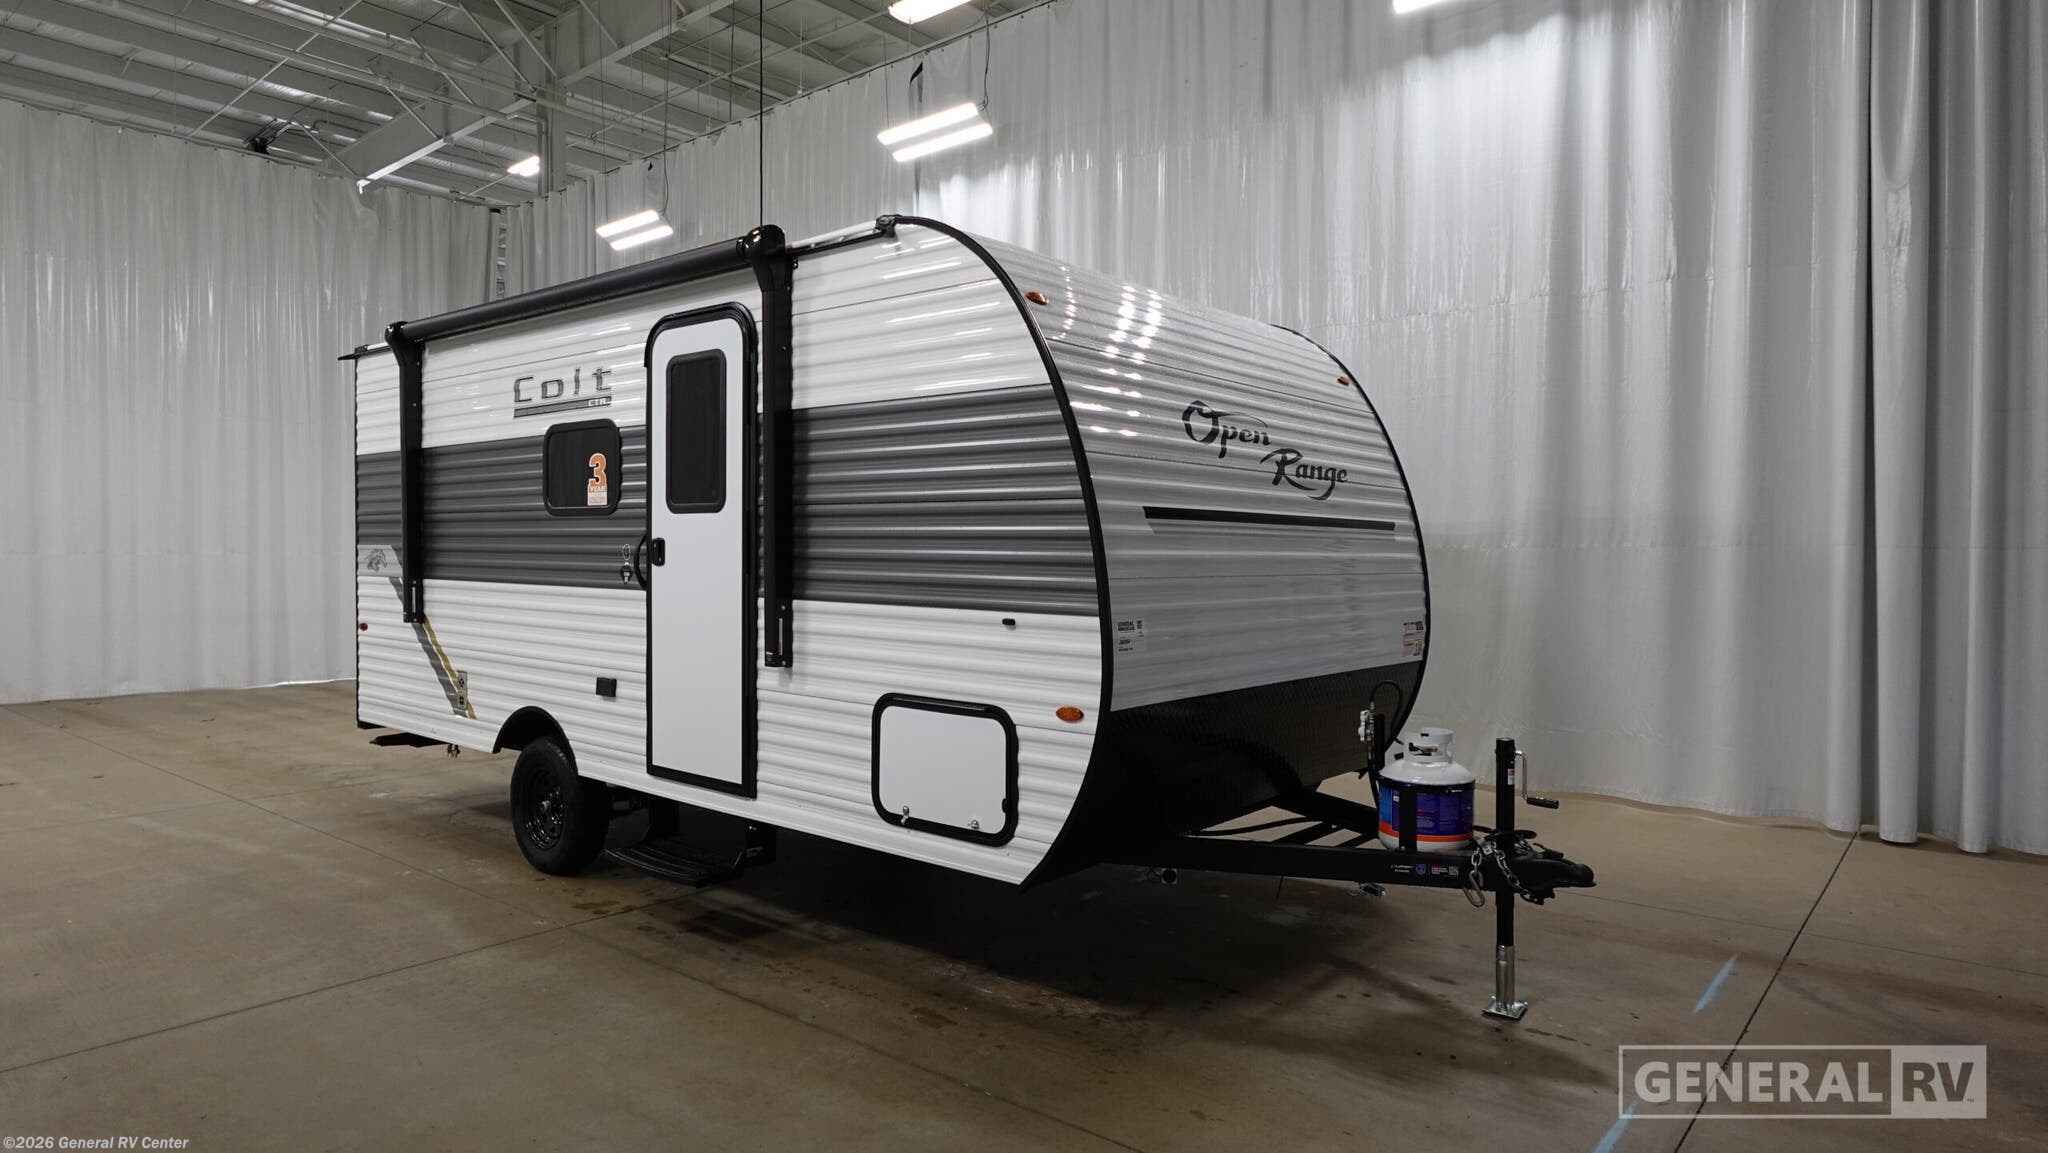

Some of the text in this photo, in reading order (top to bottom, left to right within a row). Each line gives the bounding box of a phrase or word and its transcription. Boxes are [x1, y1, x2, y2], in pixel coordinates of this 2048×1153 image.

[514, 368, 611, 402] Colt
[1182, 400, 1272, 459] Open
[589, 453, 607, 487] 3
[1260, 448, 1348, 500] Range
